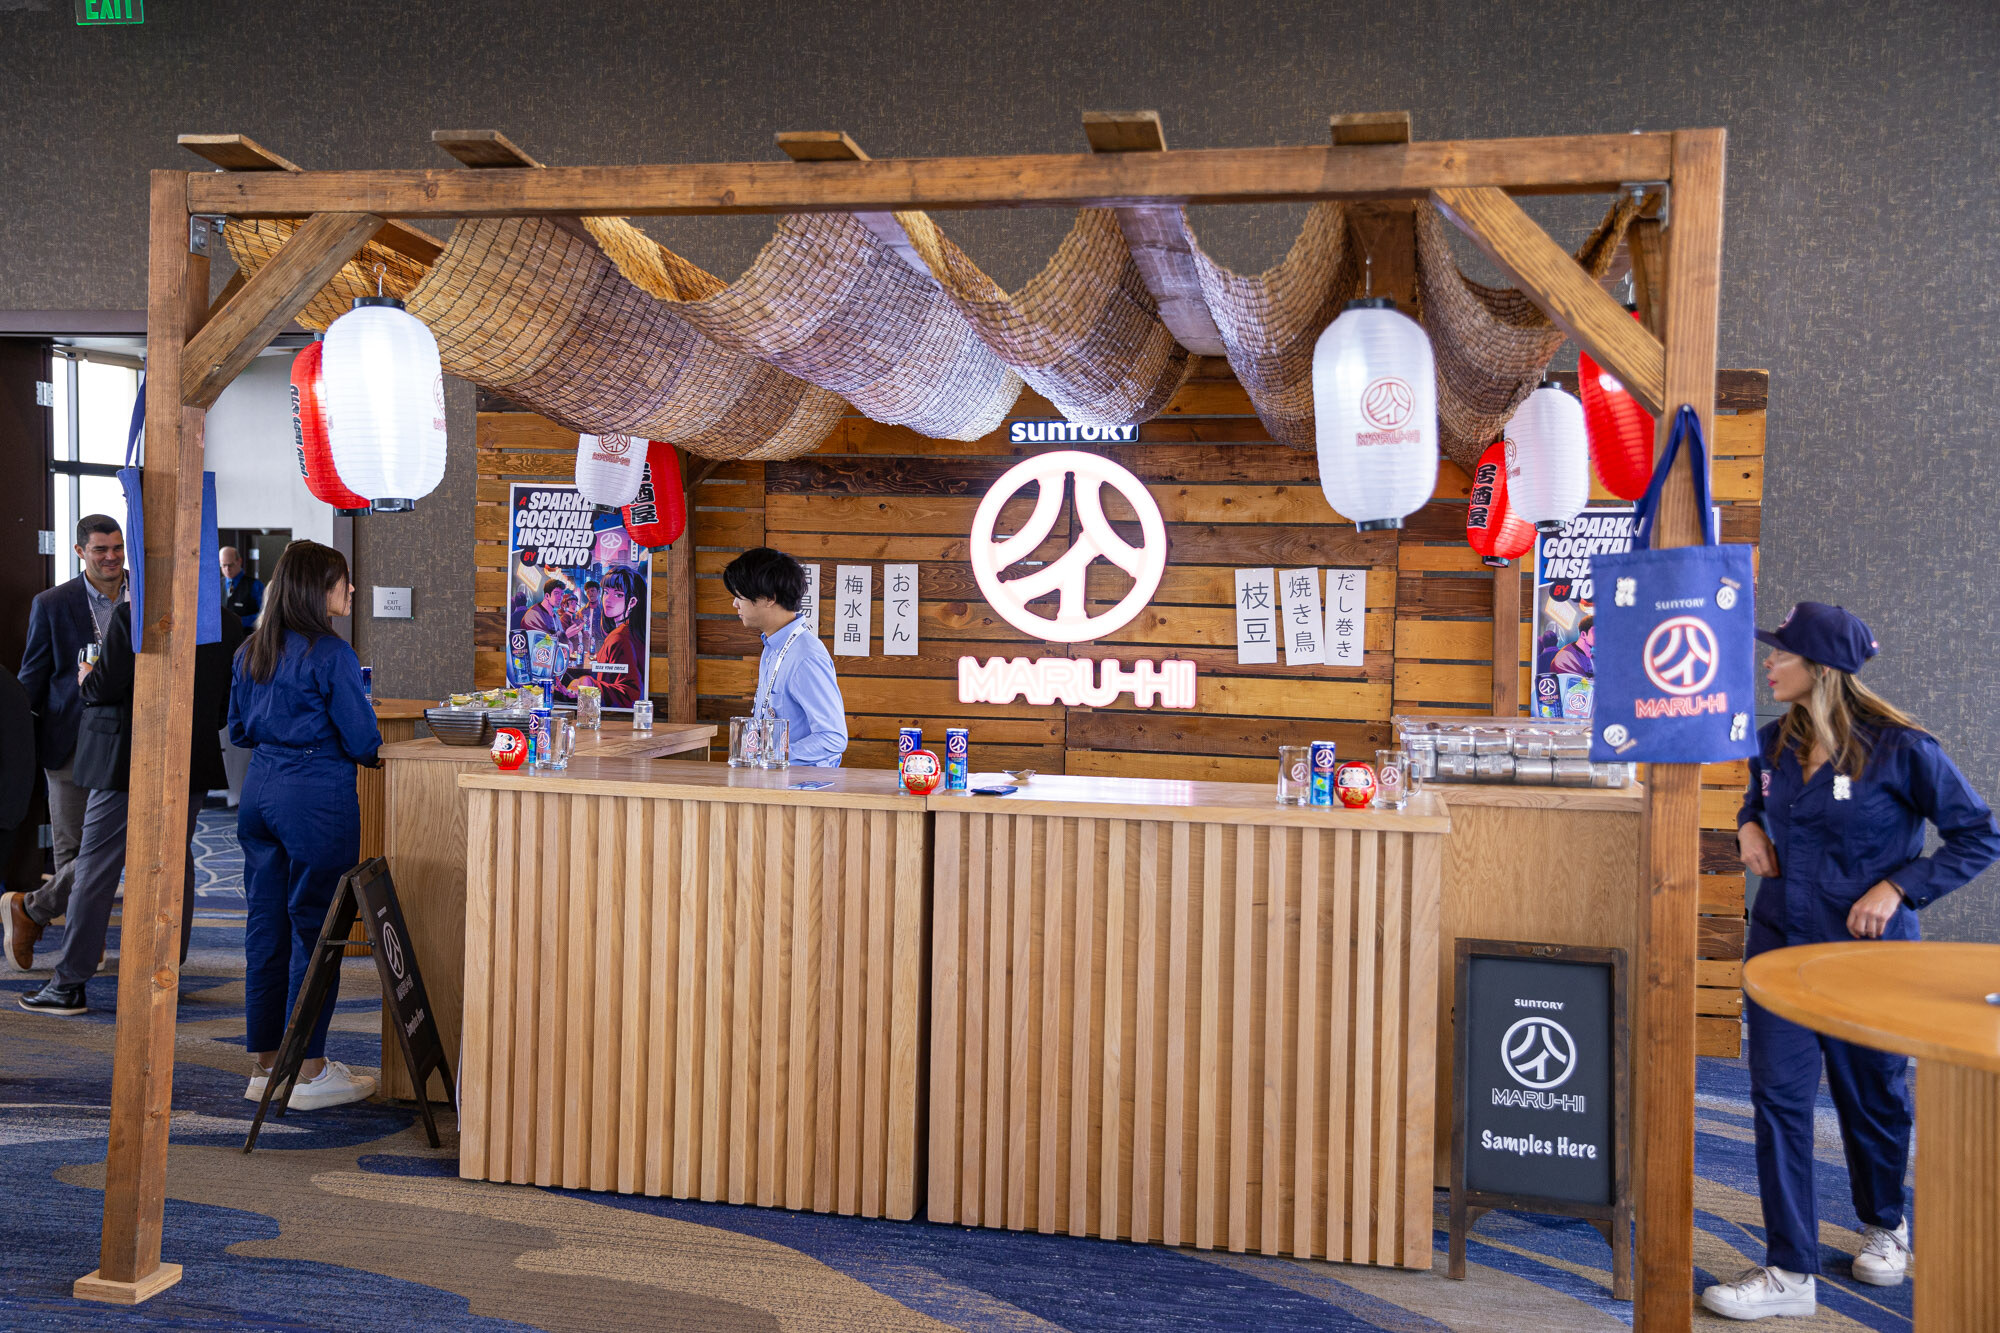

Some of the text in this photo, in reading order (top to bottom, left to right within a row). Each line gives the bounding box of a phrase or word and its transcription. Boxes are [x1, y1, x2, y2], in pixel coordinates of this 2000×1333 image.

[519, 492, 592, 510] A SPARKL
[515, 510, 593, 529] COCKTAIL
[1559, 517, 1645, 538] SPARK
[516, 528, 595, 548] INSPIRED
[1542, 537, 1632, 558] COCKTAI
[523, 547, 590, 566] BY TOKYO
[1544, 558, 1592, 579] INSP
[1553, 585, 1570, 596] BY
[844, 574, 864, 643] 梅水晶
[892, 573, 911, 642] おでん
[1242, 581, 1270, 644] 枝豆
[1288, 575, 1316, 654] 焼き鳥
[1655, 598, 1705, 610] SUNTORY
[1335, 573, 1356, 658] だし巻き
[958, 656, 1197, 708] MARU-HI
[1635, 692, 1728, 718] MARU-HI
[1514, 998, 1564, 1010] SUNTORY
[1491, 1087, 1585, 1112] MARU-HI
[1481, 1129, 1597, 1159] Samples Here
